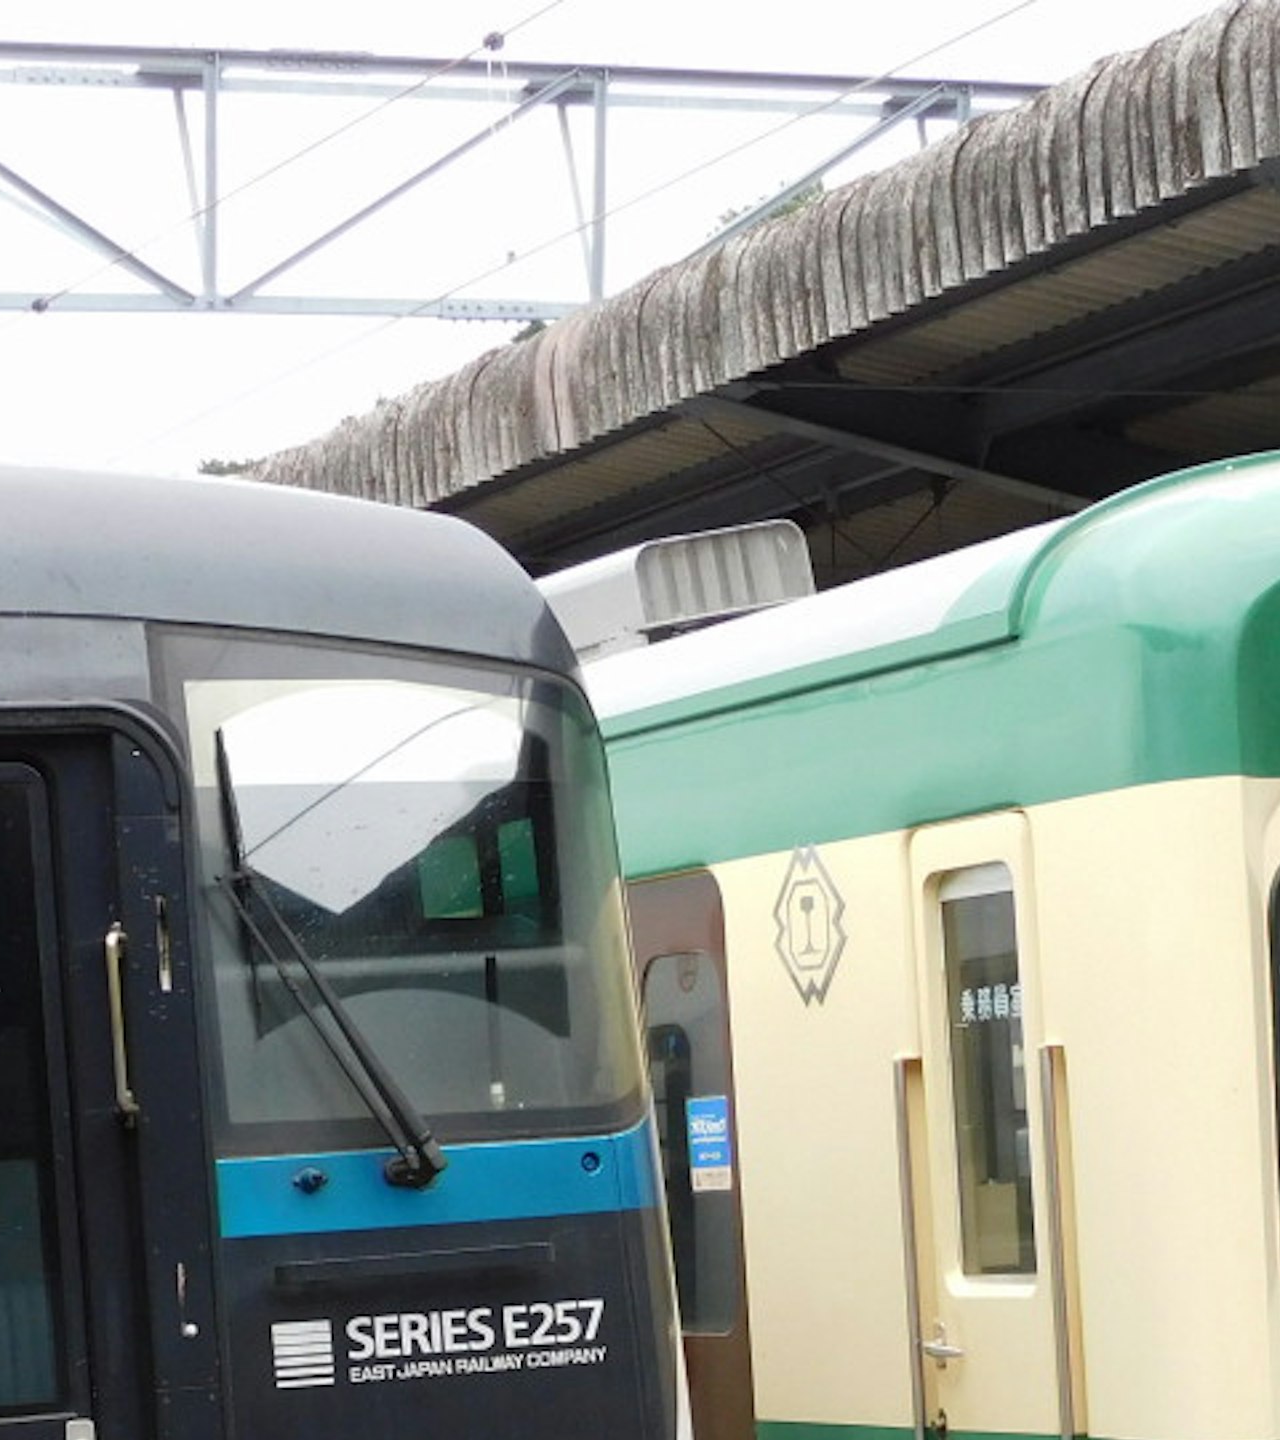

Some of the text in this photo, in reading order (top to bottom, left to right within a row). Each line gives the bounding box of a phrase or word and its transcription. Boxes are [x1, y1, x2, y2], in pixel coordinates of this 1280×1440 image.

[345, 1298, 606, 1360] SERIES E257
[349, 1346, 608, 1383] EAST JAPAN RAILWAY COMPANY
